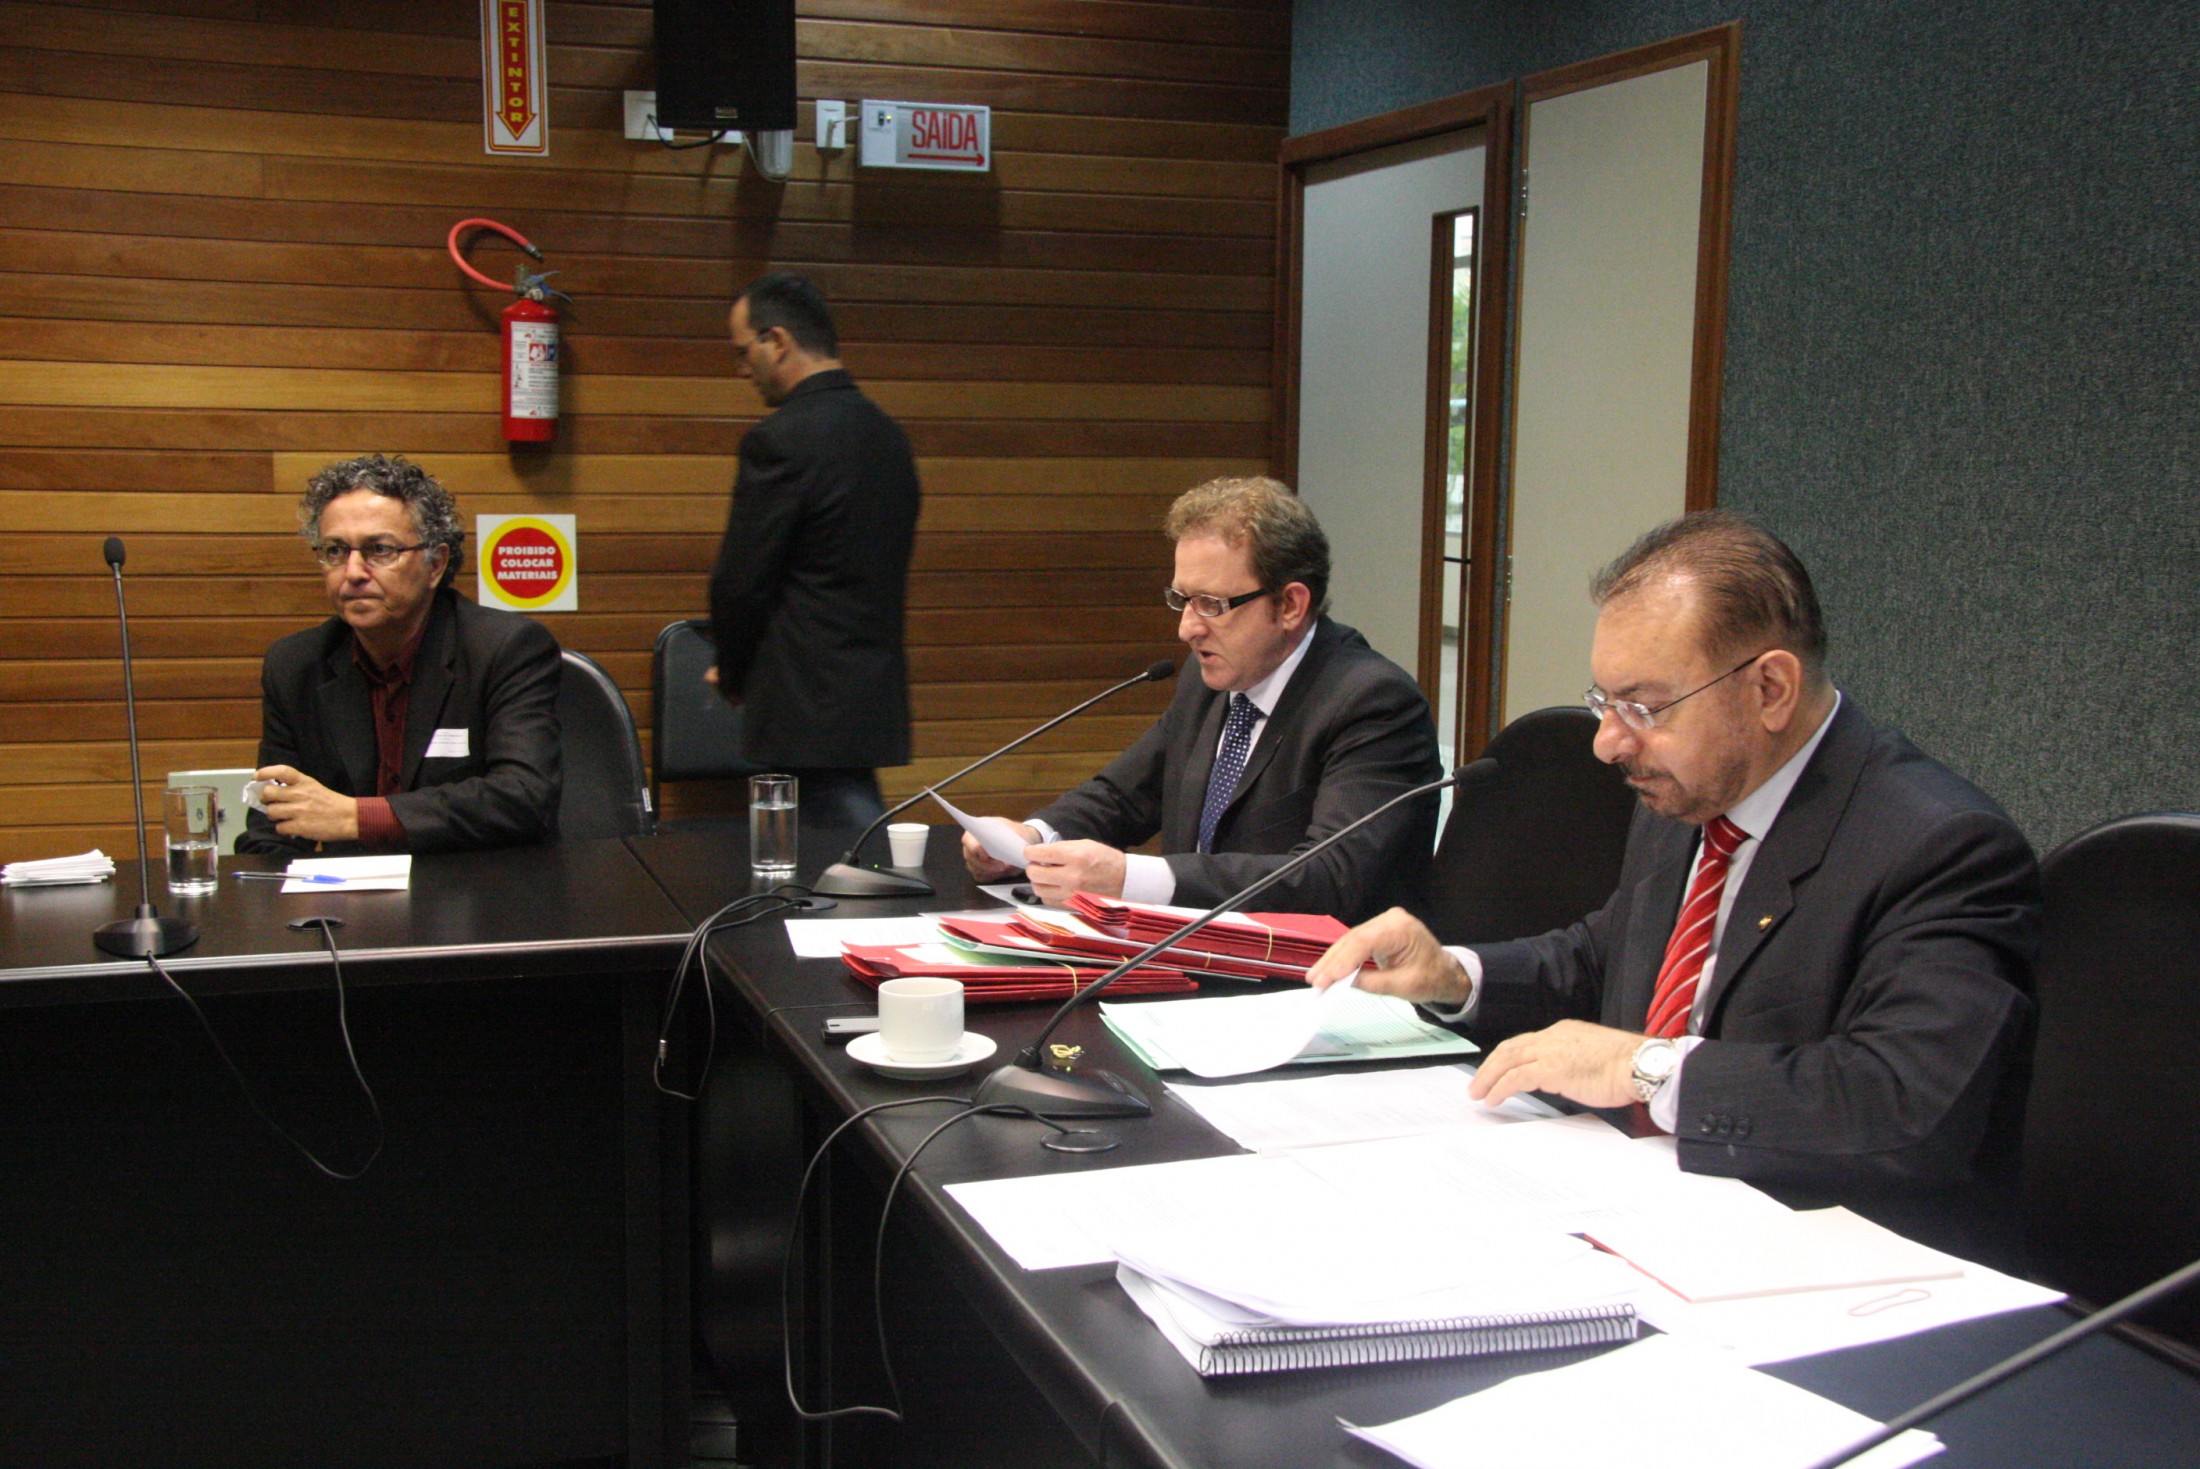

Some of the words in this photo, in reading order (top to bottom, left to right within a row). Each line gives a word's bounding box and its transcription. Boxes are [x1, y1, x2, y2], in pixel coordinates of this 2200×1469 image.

[507, 7, 524, 122] EXTINTOR
[498, 546, 556, 555] PROIBIDO
[501, 558, 555, 568] COLOCAR
[497, 570, 558, 580] MATERIAIS
